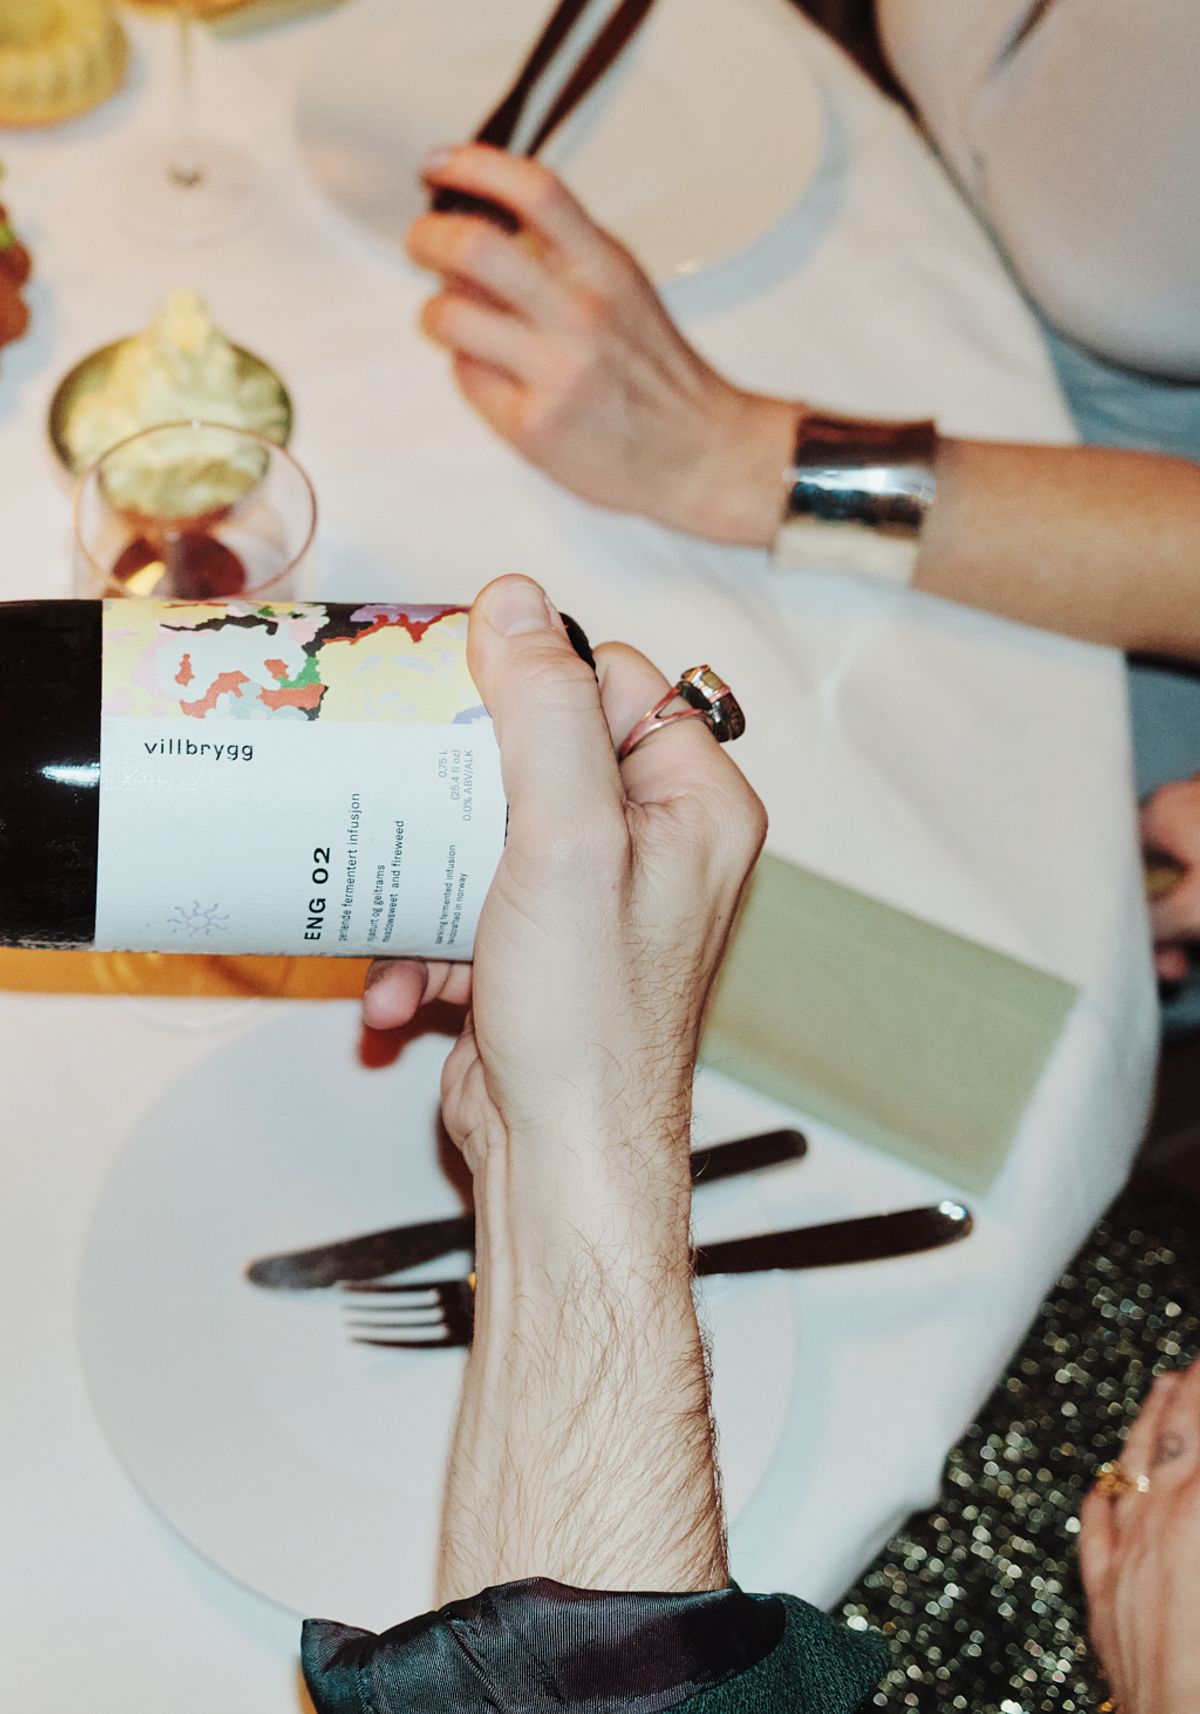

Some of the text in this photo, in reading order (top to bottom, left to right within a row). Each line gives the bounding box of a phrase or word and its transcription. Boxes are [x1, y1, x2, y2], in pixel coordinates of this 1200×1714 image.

[144, 739, 255, 761] villbrygg
[451, 749, 461, 764] oz)
[451, 776, 462, 800] (25.4
[463, 750, 474, 821] 0.0% ABV/ALK
[346, 793, 362, 845] infusjon
[391, 820, 404, 867] fireweed
[341, 850, 357, 907] fermentert
[373, 864, 385, 906] geitrams
[390, 870, 401, 888] and
[438, 883, 452, 920] fermented
[445, 845, 456, 880] infusion
[456, 872, 468, 901] norway
[304, 898, 326, 940] ENG
[372, 908, 383, 918] og
